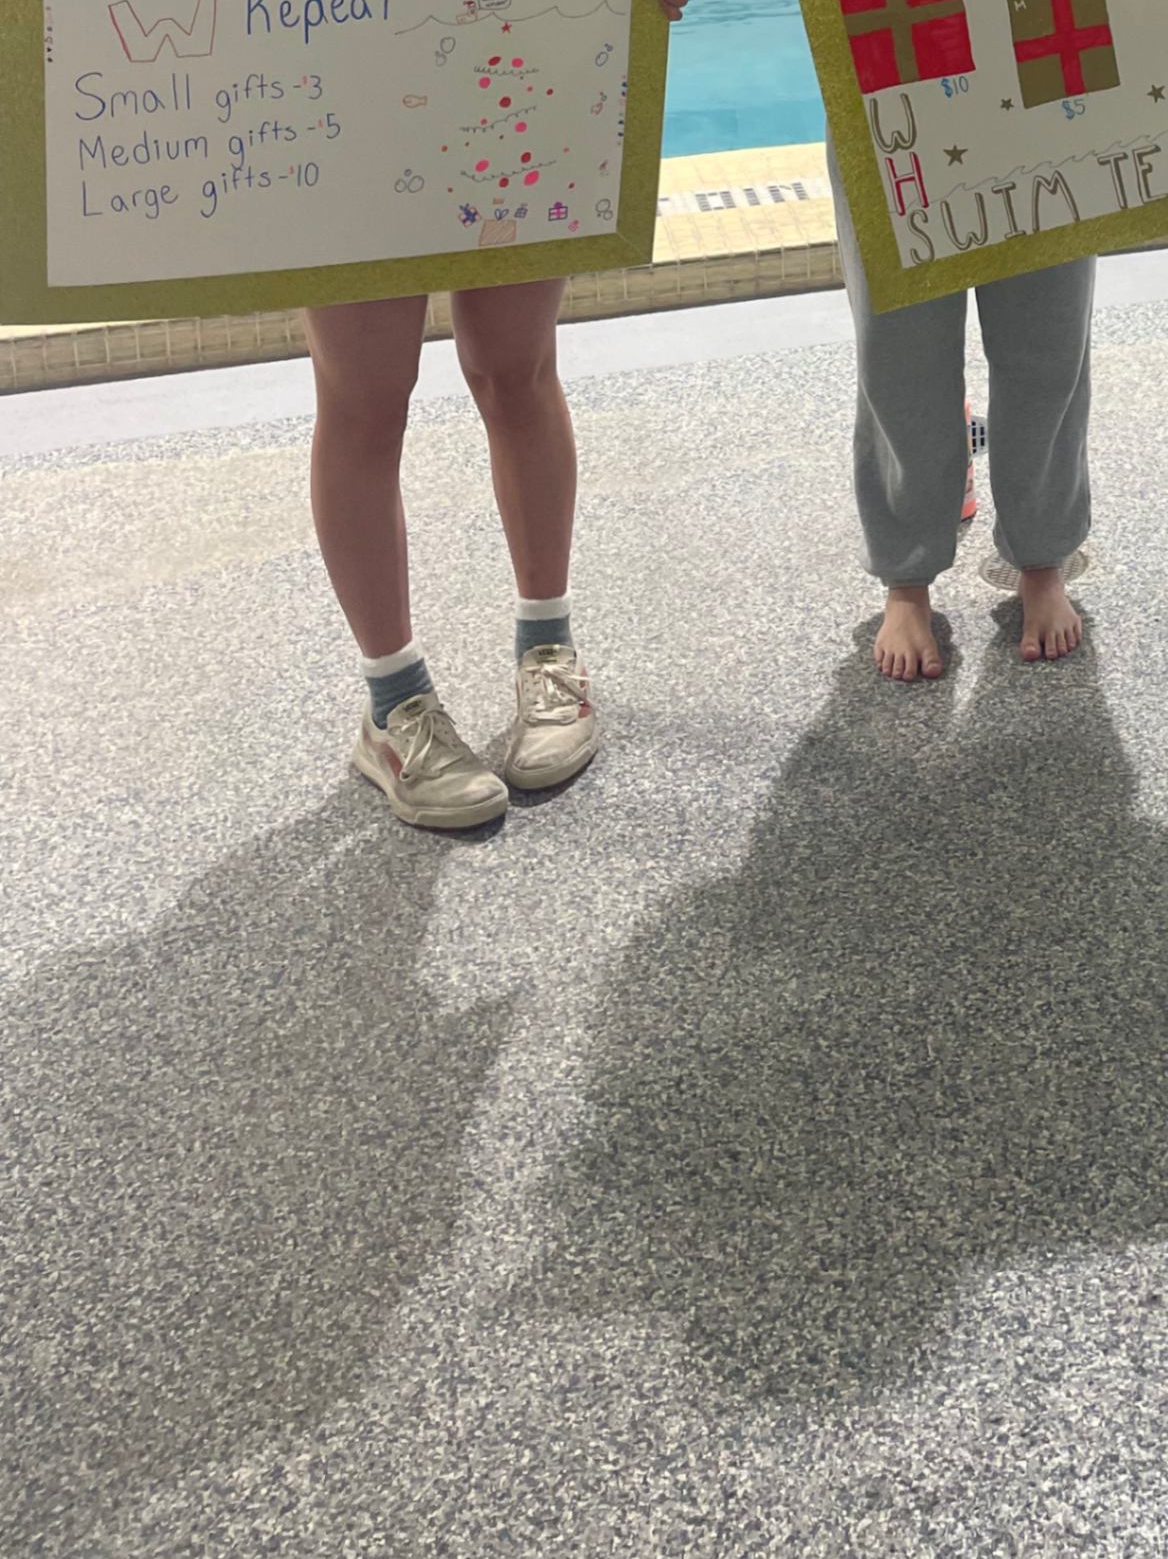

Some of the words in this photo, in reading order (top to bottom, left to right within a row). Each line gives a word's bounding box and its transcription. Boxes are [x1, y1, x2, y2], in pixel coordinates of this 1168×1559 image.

[75, 71, 191, 121] Small
[941, 75, 970, 98] $10
[1061, 98, 1086, 120] $5
[79, 130, 208, 171] Medium
[82, 180, 179, 219] Large
[908, 170, 1080, 266] SWIM
